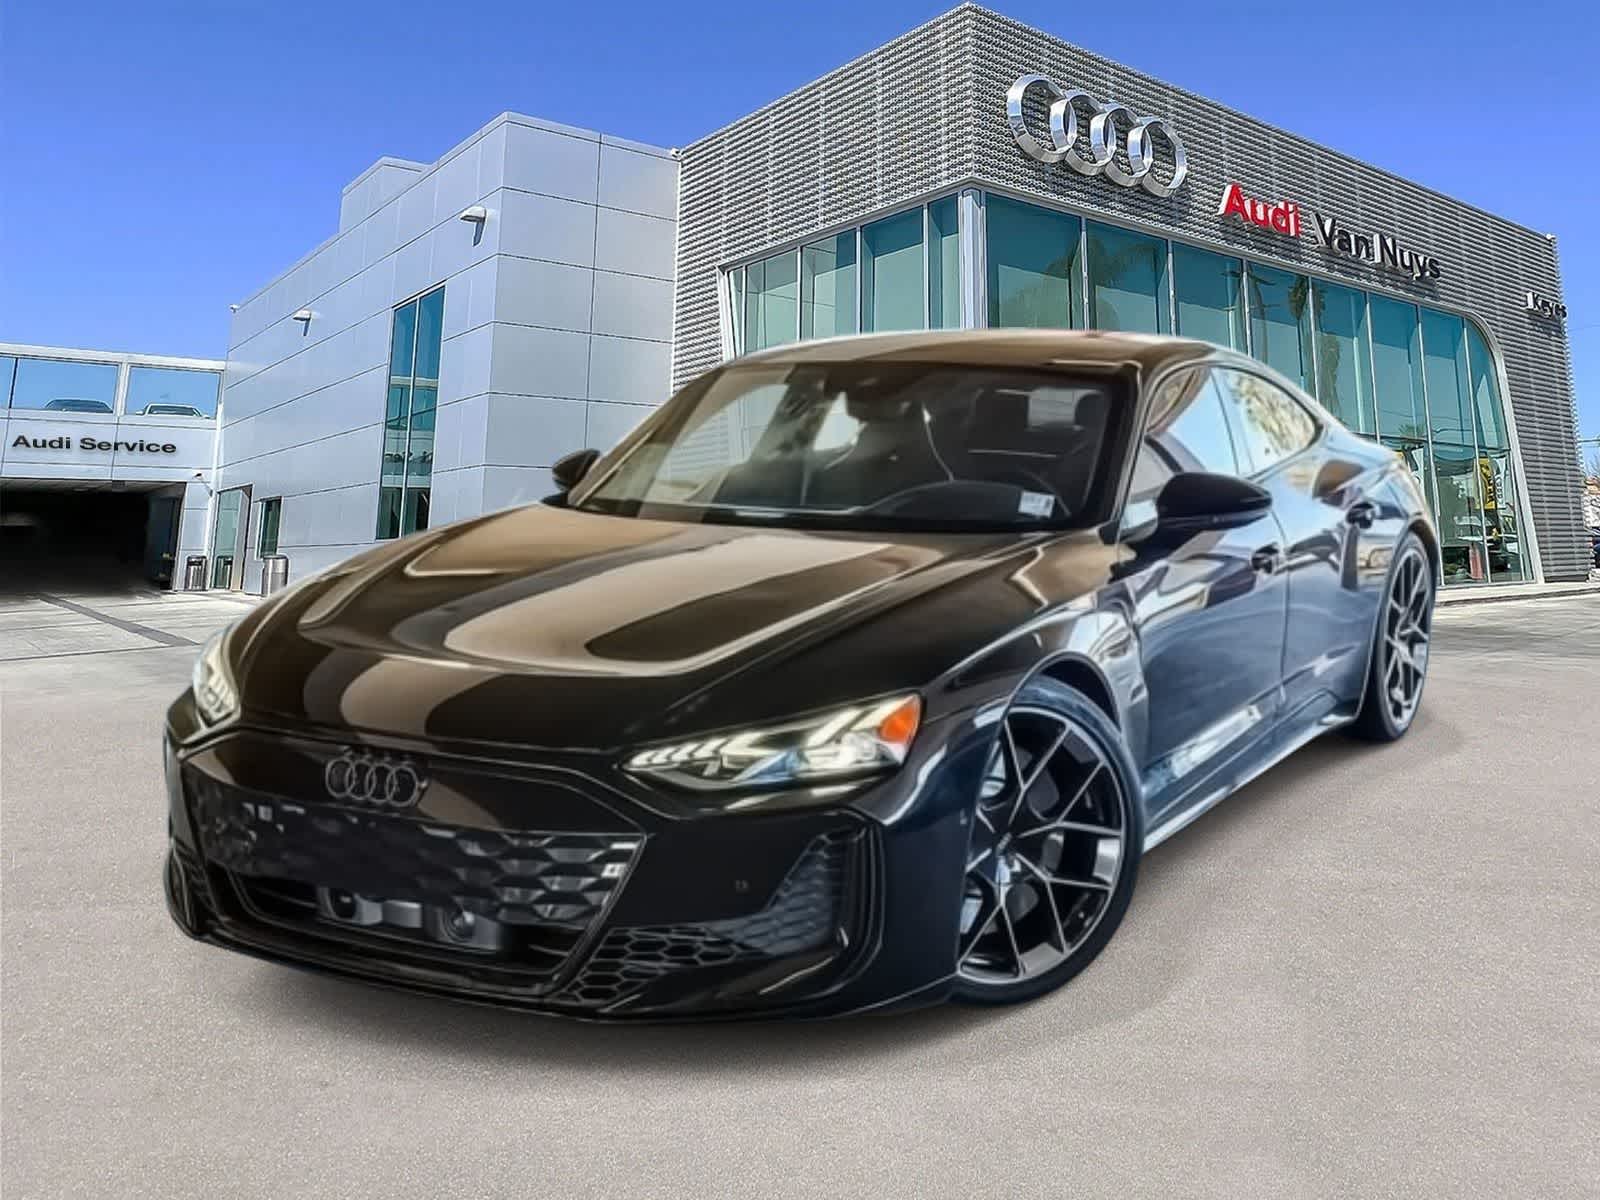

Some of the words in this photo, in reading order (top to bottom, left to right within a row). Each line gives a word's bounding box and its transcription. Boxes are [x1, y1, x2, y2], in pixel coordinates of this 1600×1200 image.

[1217, 182, 1302, 238] Audi
[1312, 212, 1370, 259] Van
[1373, 232, 1442, 282] Nuys
[12, 435, 72, 449] Audi
[79, 437, 177, 454] Service
